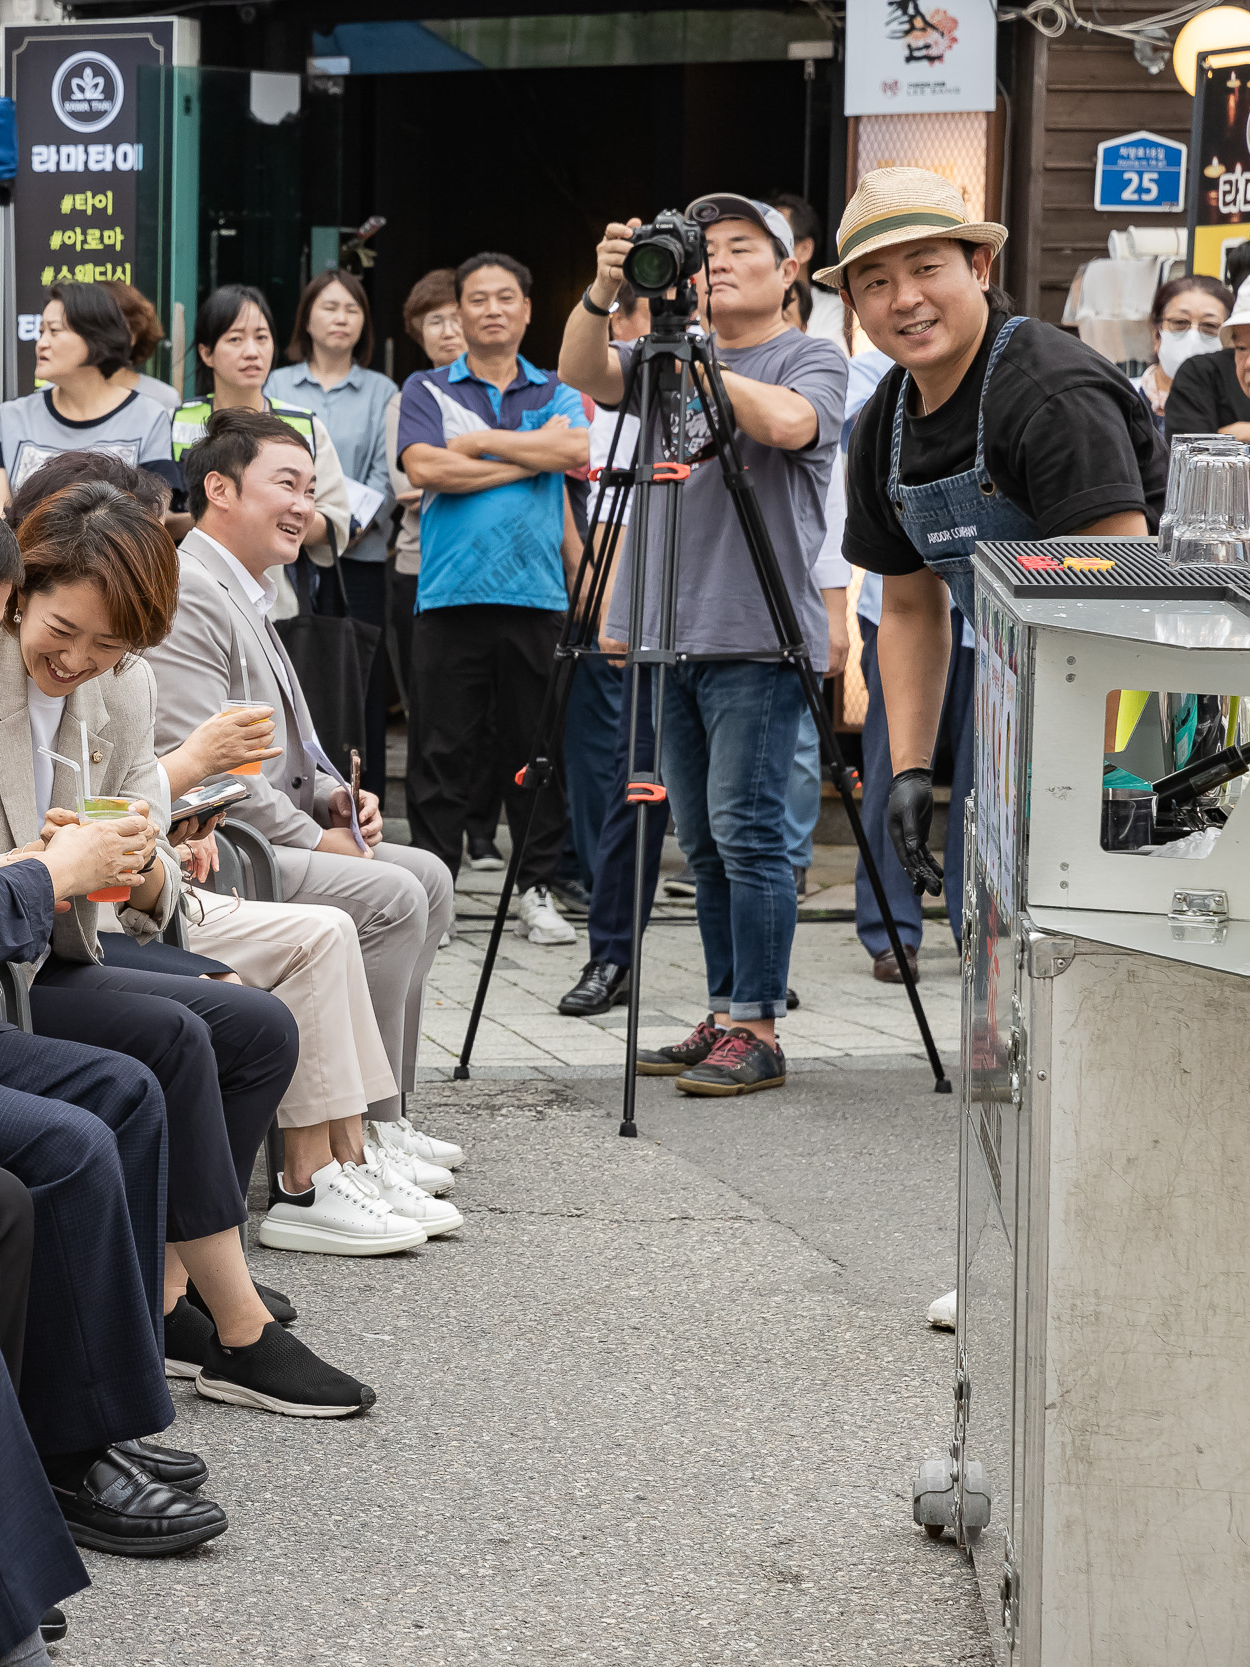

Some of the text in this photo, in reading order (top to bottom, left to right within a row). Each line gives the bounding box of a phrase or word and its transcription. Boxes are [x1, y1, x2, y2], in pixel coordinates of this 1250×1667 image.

[31, 143, 143, 173] 라마타이
[1121, 171, 1159, 202] 25
[60, 190, 113, 216] #타이
[49, 226, 125, 252] #아로마
[40, 262, 131, 286] #스웨디시
[927, 530, 952, 544] ARDOR
